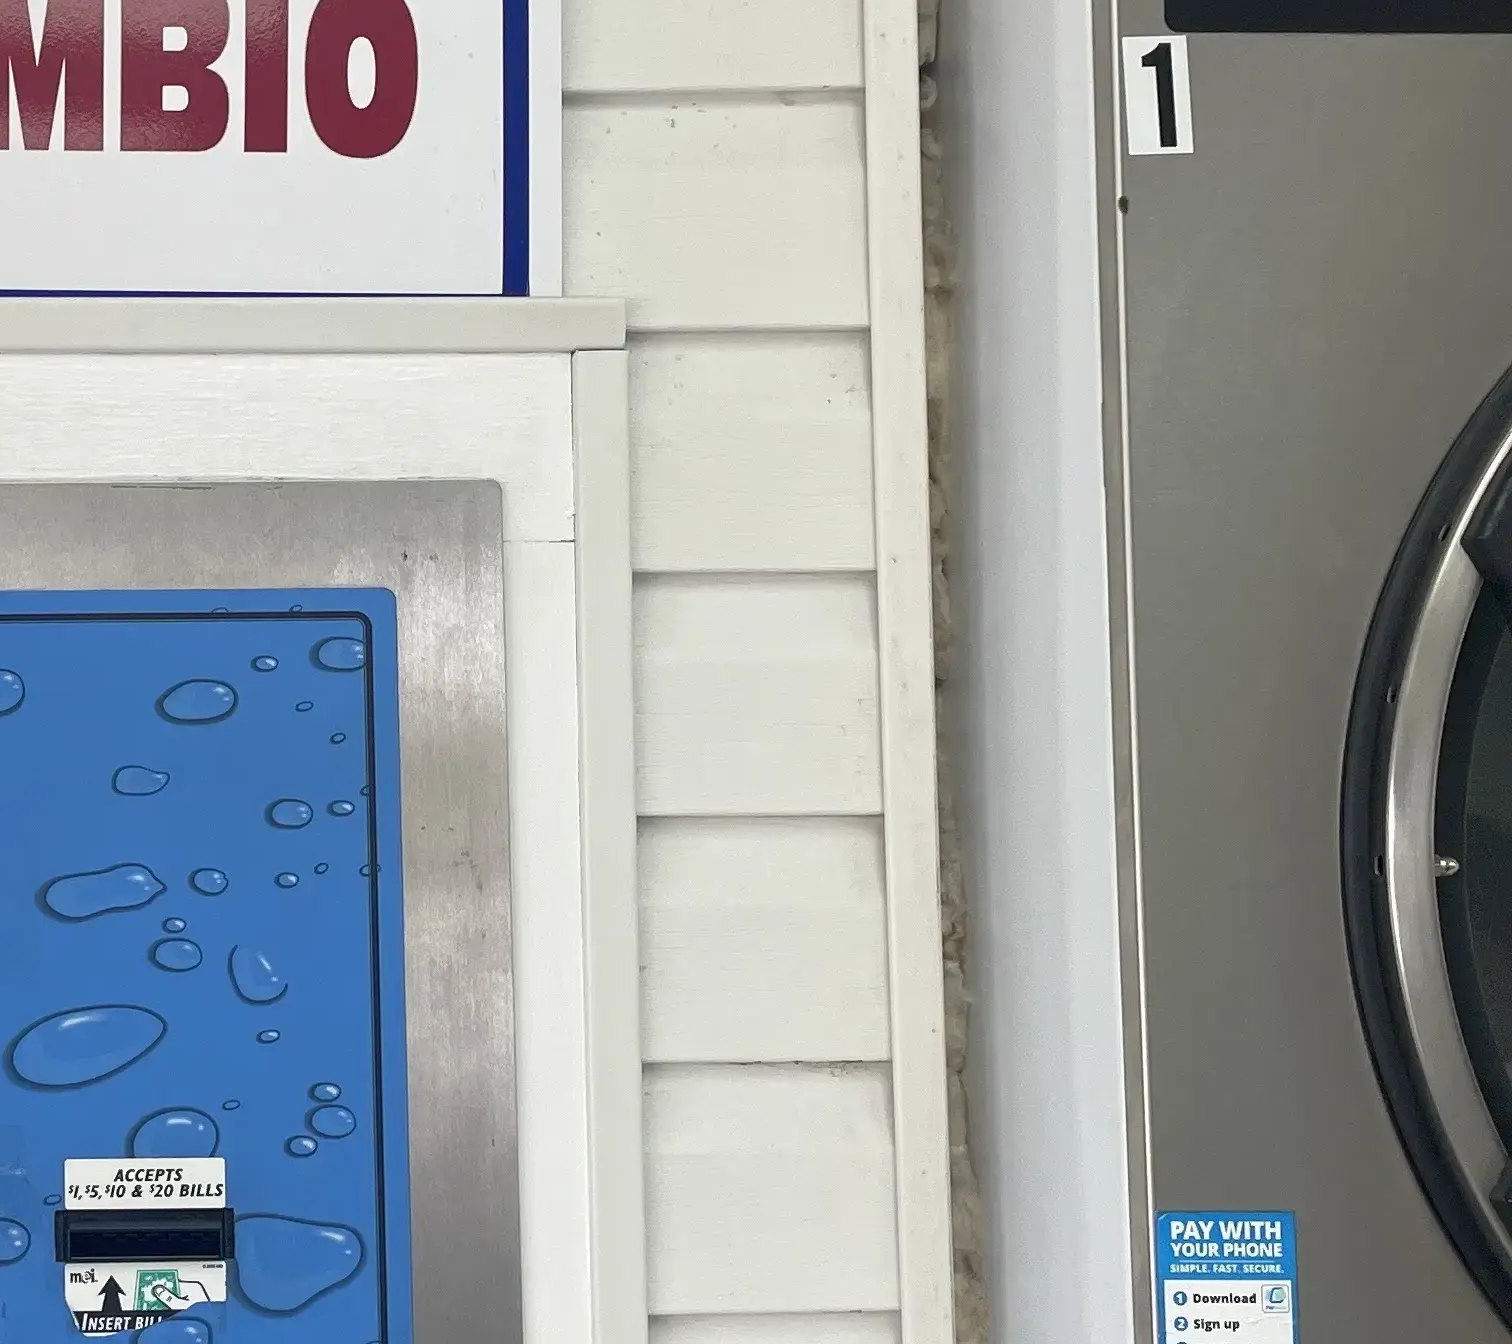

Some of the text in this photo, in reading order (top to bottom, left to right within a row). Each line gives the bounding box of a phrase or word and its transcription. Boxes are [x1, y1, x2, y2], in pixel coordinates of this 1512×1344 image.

[1141, 43, 1177, 147] 1
[114, 1168, 183, 1182] ACCEPTS
[132, 1185, 143, 1197] &
[150, 1184, 173, 1197] $20
[179, 1184, 223, 1197] BILLS
[1170, 1221, 1282, 1241] PAY WITH
[1171, 1243, 1283, 1258] YOUR PHONE
[1193, 1292, 1257, 1305] Download
[1194, 1319, 1218, 1332] Sign
[1222, 1321, 1240, 1332] up
